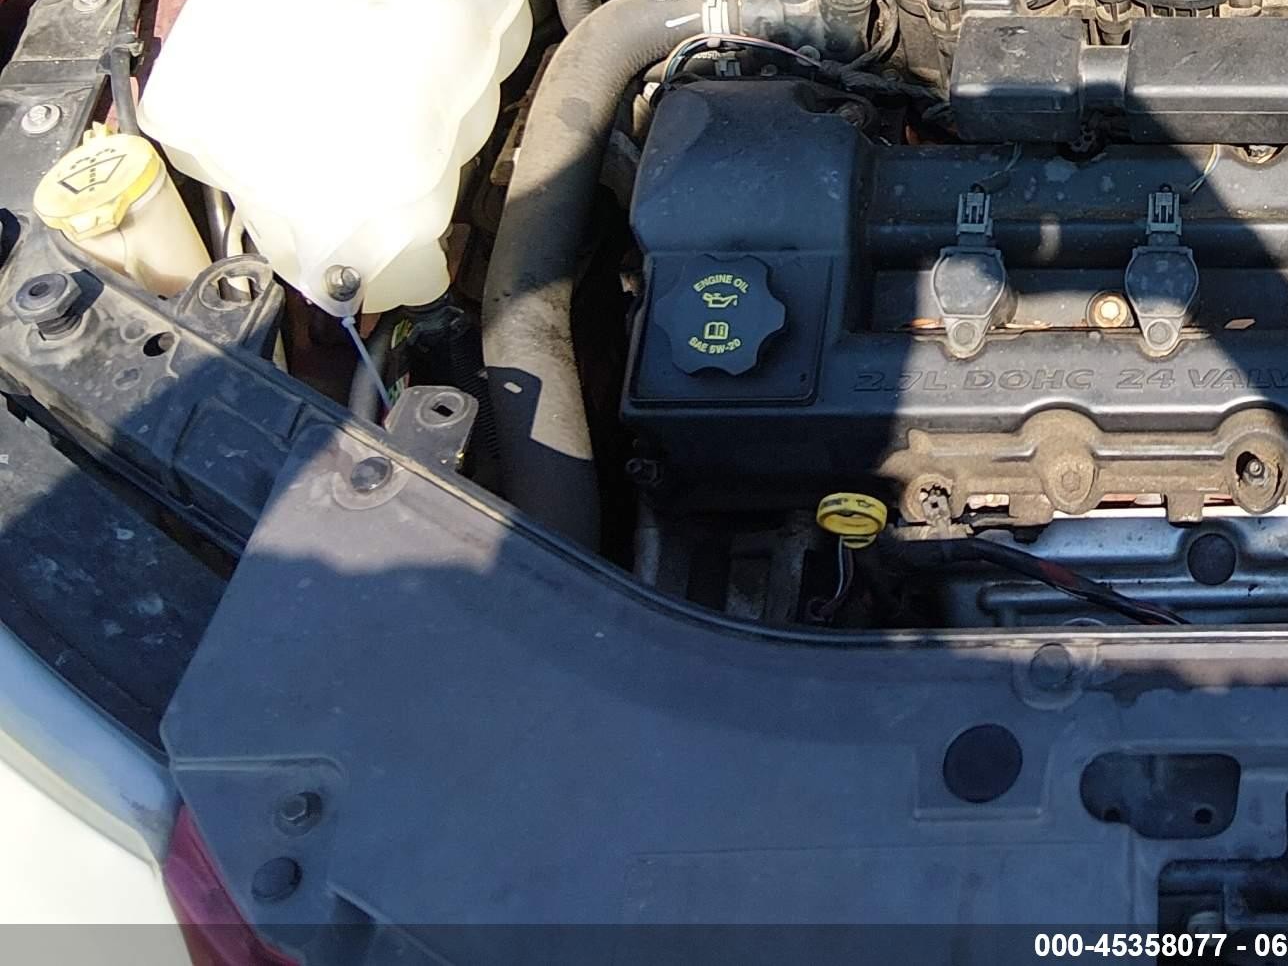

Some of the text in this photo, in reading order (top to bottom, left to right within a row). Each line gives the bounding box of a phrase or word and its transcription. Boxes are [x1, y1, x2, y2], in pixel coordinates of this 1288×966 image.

[693, 274, 749, 293] ENGINE OIL
[688, 337, 741, 354] SAE 5W-20
[853, 370, 948, 392] 2.7L
[962, 369, 1094, 391] DOHC
[1116, 368, 1176, 390] 24
